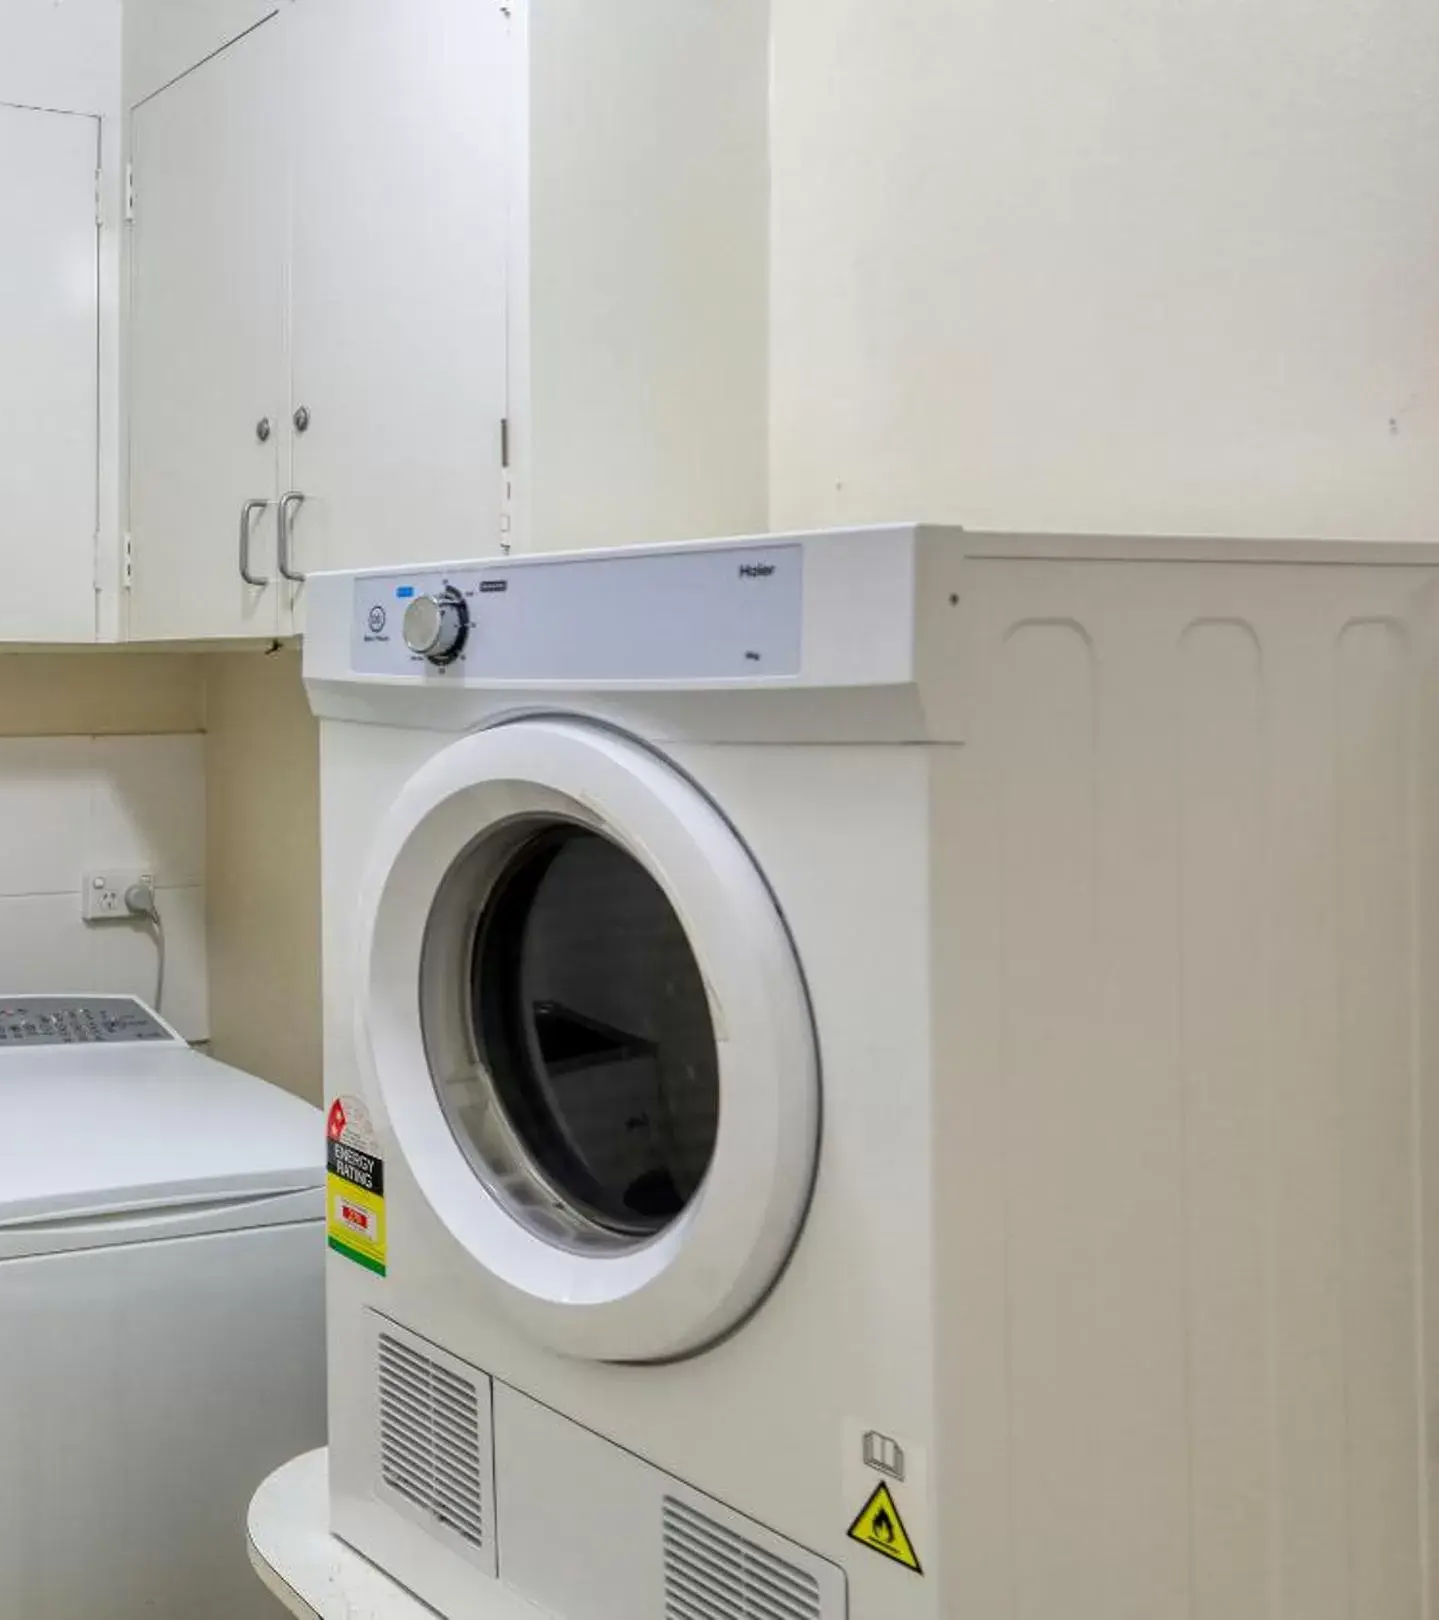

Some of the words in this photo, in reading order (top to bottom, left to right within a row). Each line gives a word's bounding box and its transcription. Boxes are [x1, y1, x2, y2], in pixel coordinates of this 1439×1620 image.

[739, 565, 776, 577] Haier
[334, 1144, 374, 1173] ENERGY
[336, 1162, 373, 1188] RATING
